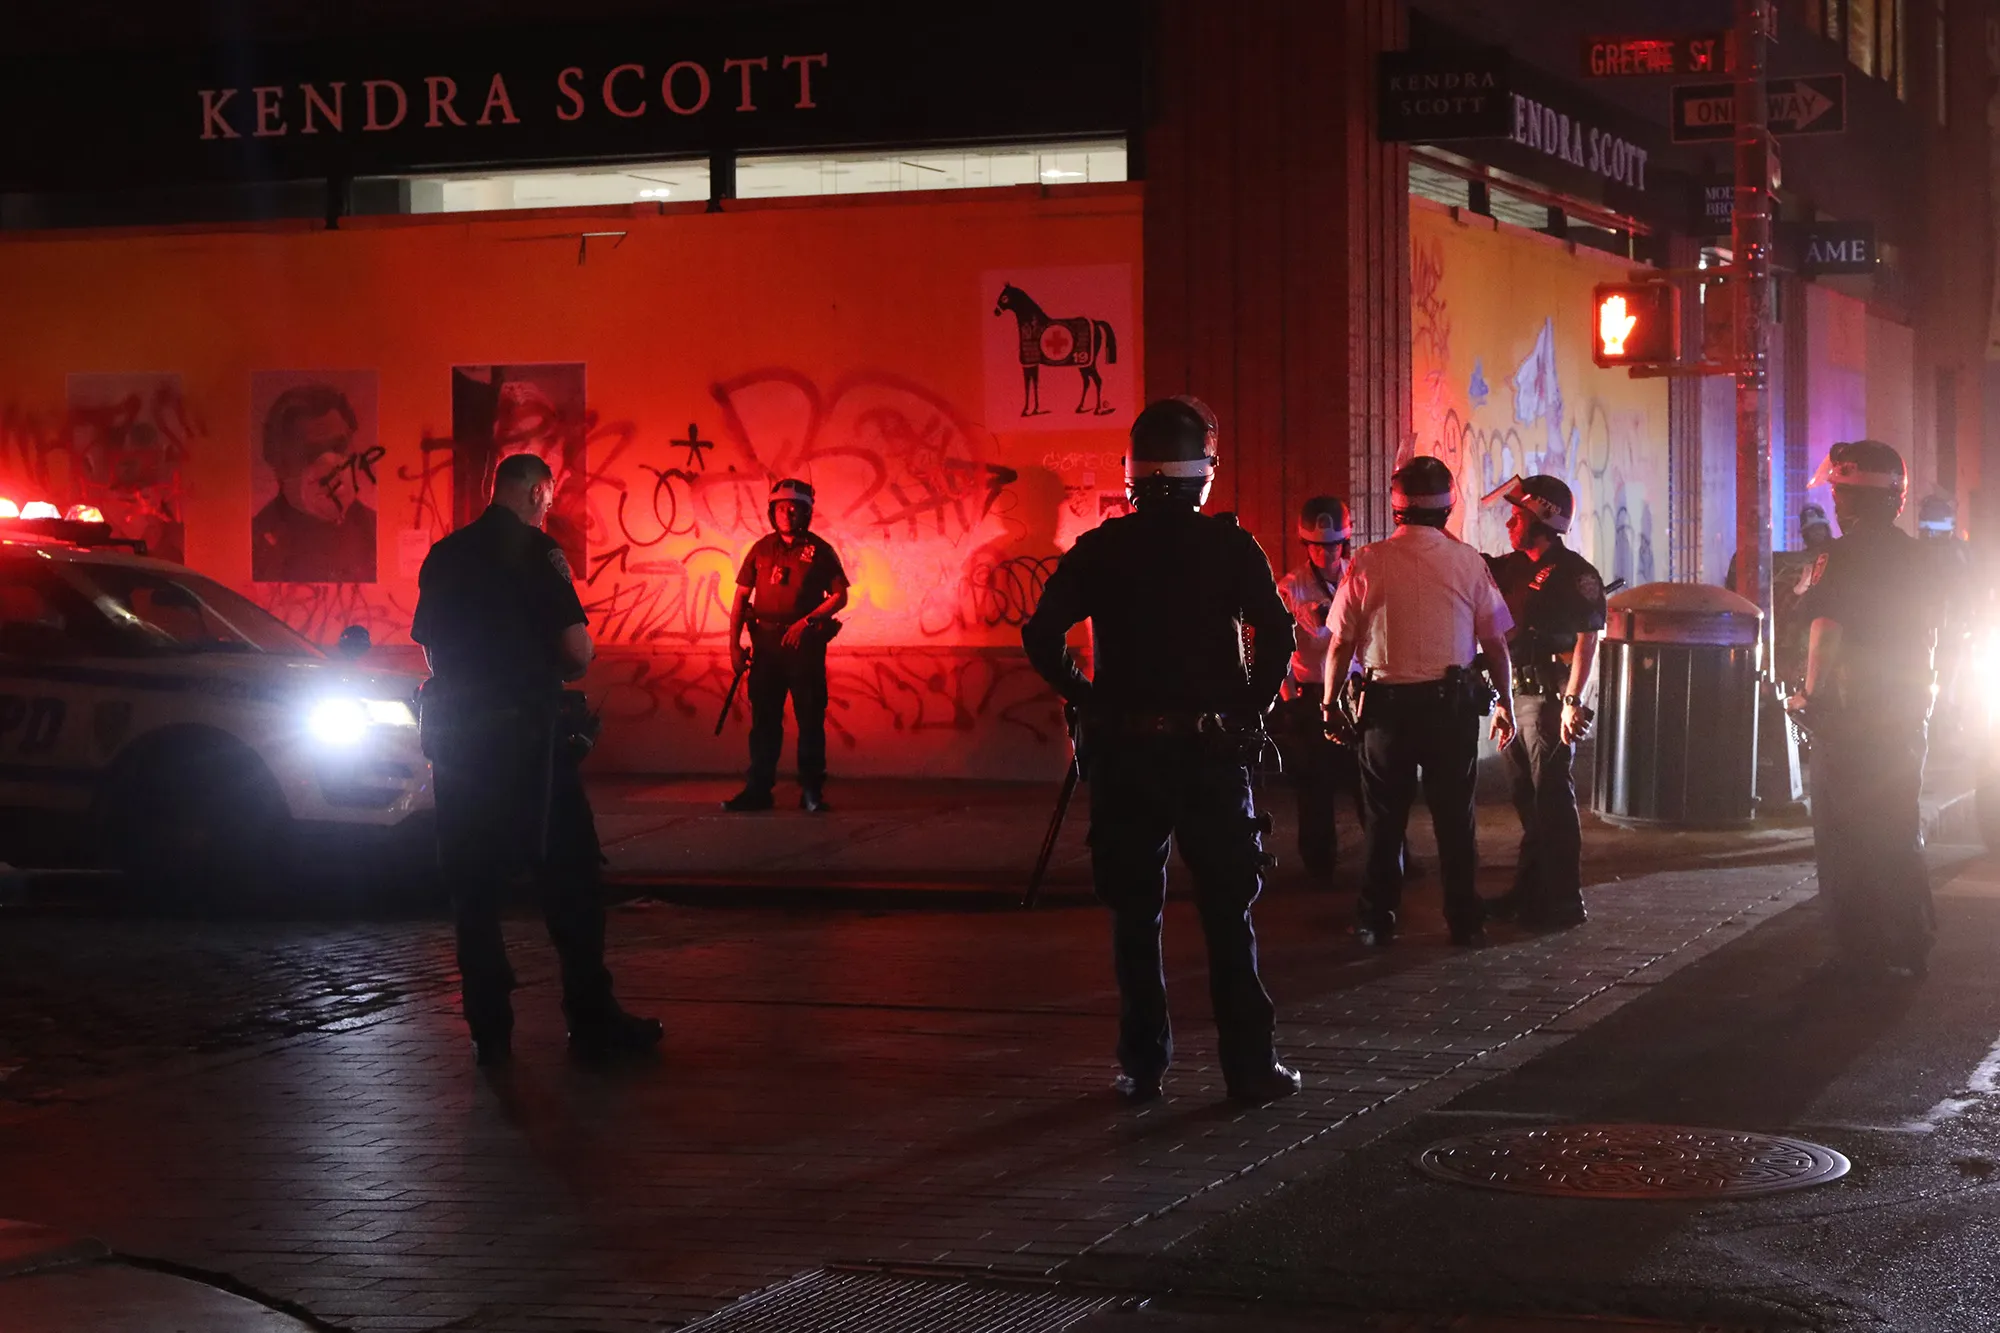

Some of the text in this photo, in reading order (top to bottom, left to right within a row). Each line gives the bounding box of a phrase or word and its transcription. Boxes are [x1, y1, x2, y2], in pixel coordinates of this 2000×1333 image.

[1688, 39, 1716, 72] ST
[1389, 71, 1496, 92] KENDRA
[198, 52, 830, 140] KENDRA SCOTT
[1400, 96, 1487, 117] SCOTT
[1697, 95, 1816, 123] ON WAY
[1509, 91, 1648, 192] ENDRA SCOTT
[1704, 185, 1734, 201] MOL
[1704, 201, 1735, 217] BRO
